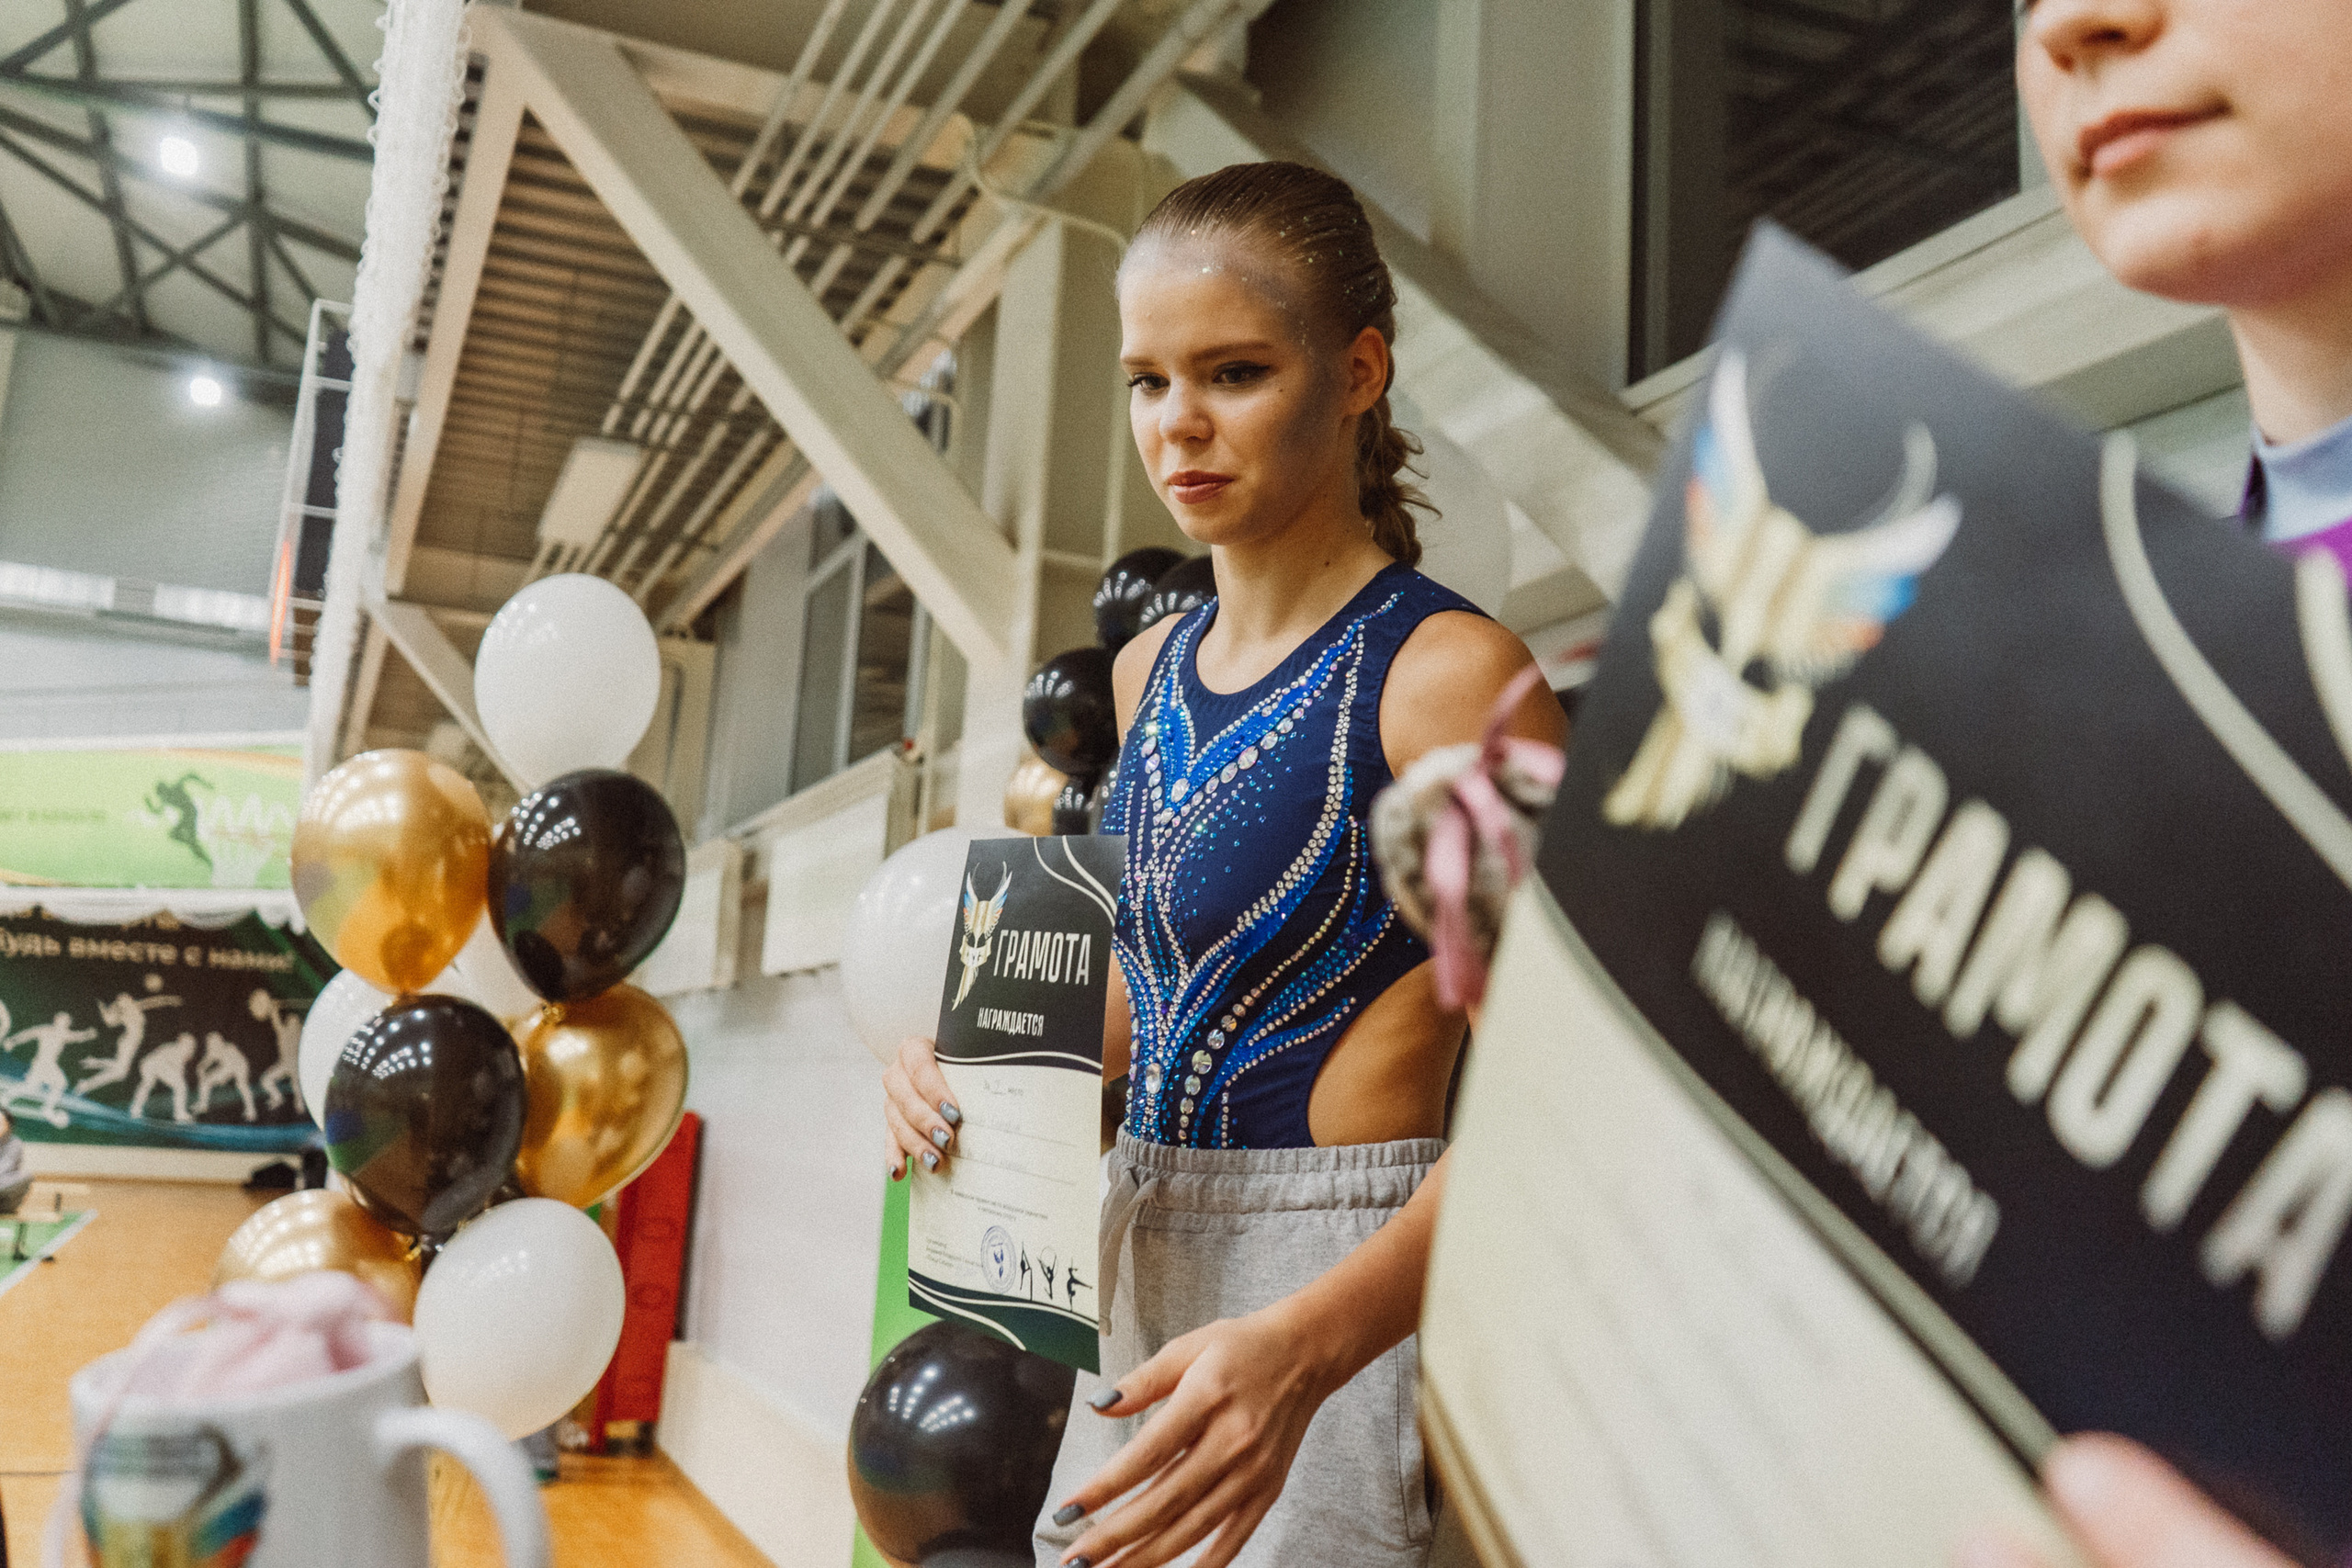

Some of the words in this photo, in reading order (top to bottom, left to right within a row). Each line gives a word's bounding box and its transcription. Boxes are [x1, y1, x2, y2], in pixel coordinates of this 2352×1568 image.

[993, 930, 1091, 986] ГРАМОТА
[977, 1007, 1045, 1037] НАГРАЖДАЕТСЯ
[1784, 701, 2352, 1343] ГРАМОТА
